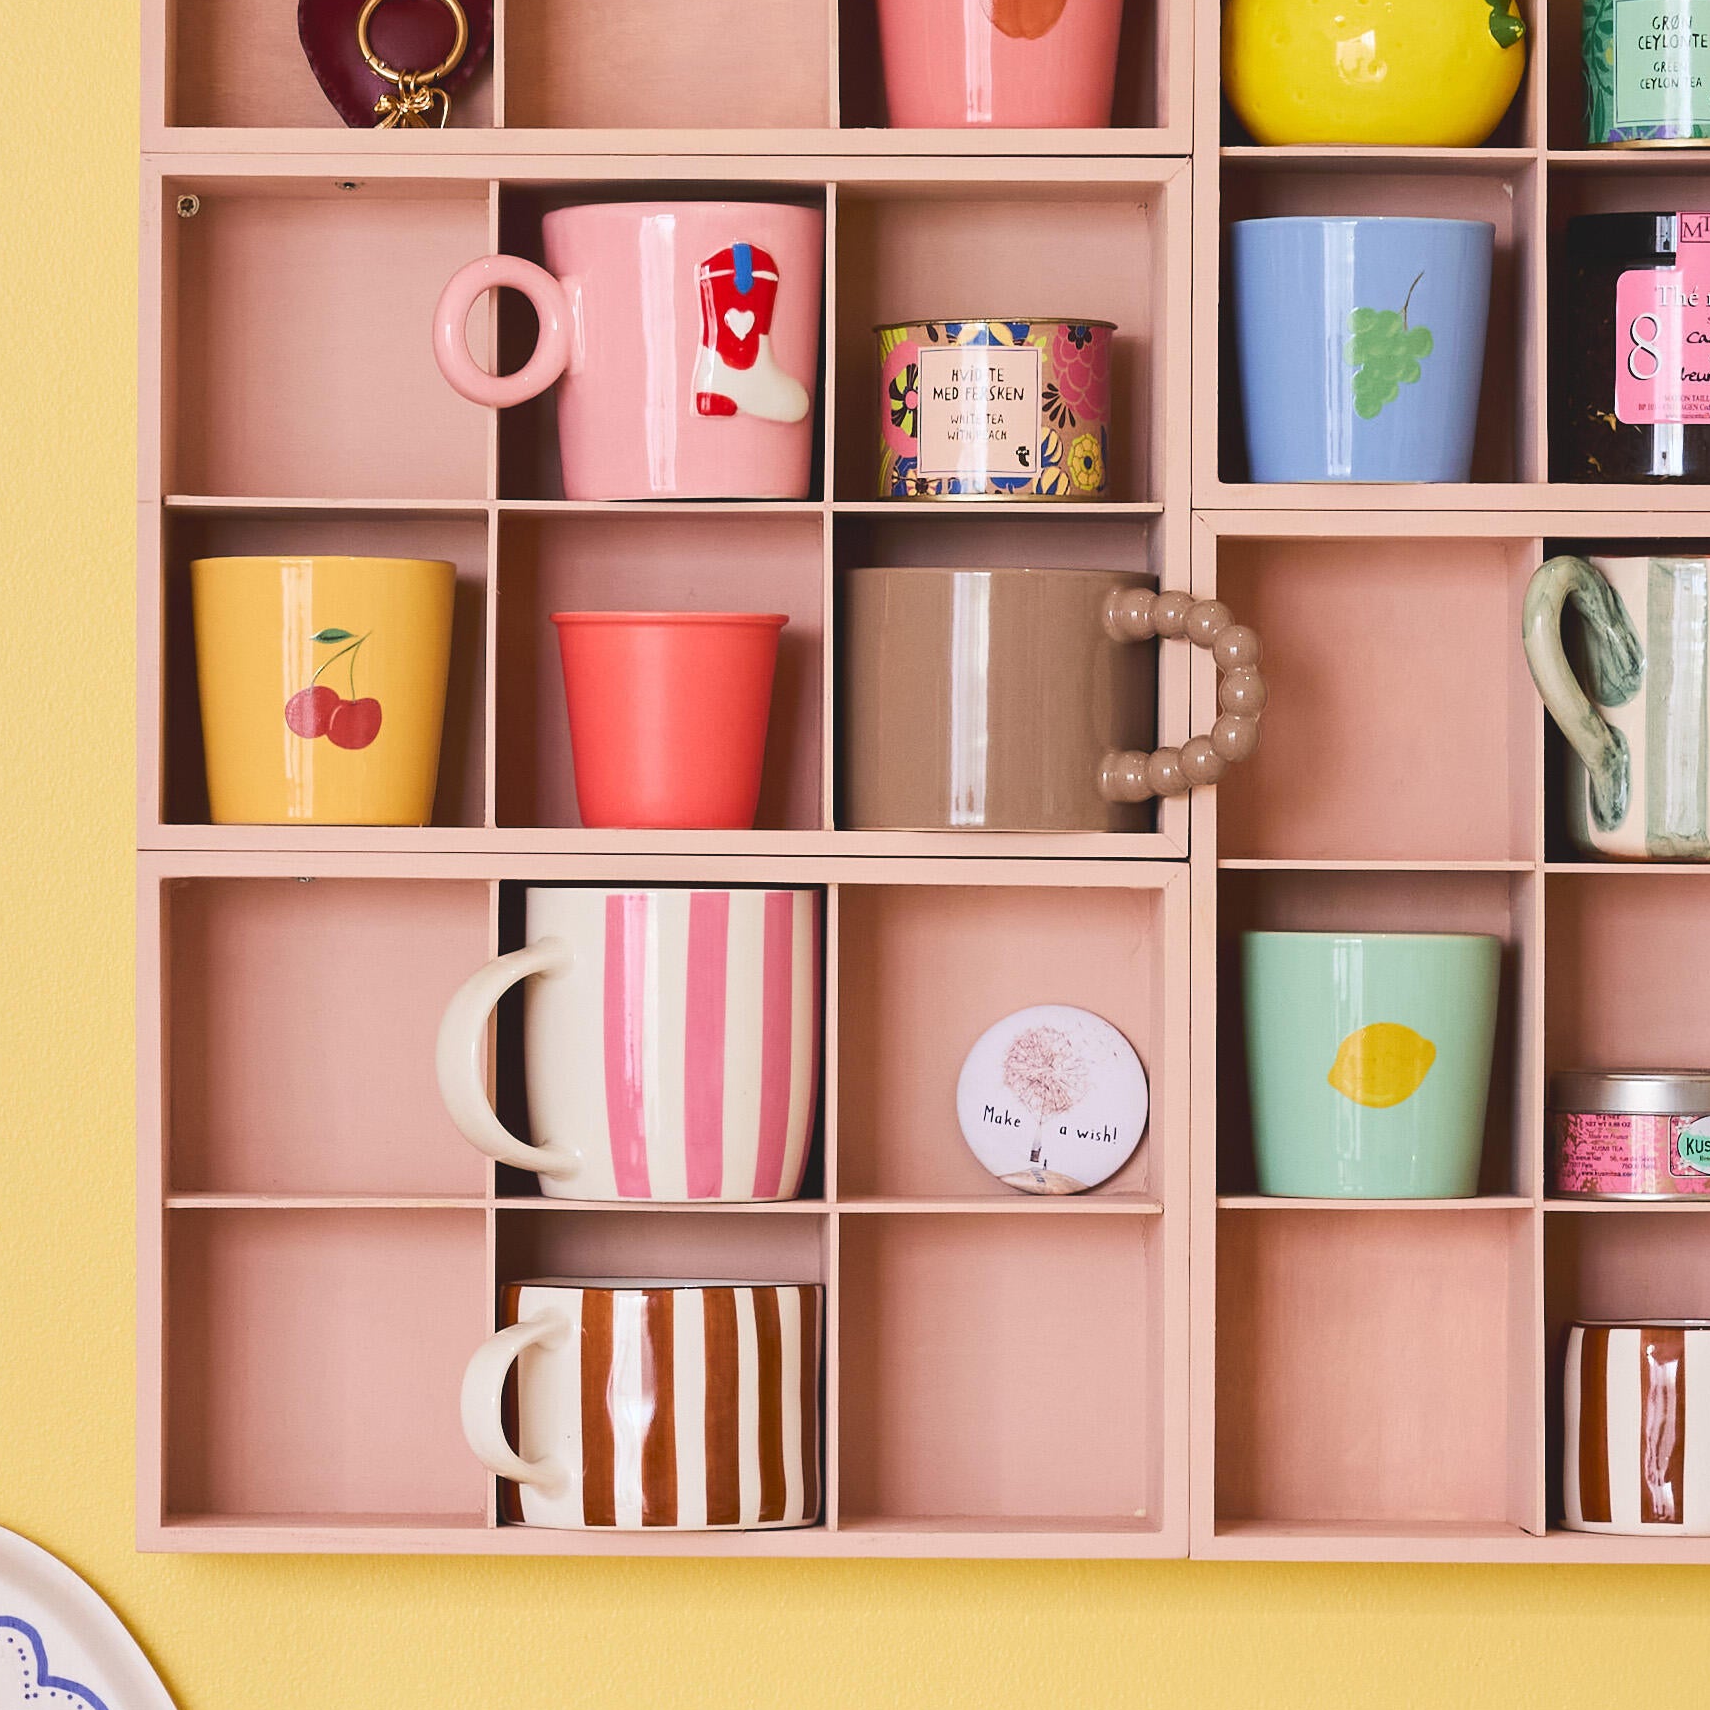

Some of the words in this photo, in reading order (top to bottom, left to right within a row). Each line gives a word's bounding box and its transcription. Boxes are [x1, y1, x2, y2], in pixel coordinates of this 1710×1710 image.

[1653, 61, 1689, 73] GREE
[1640, 77, 1679, 91] CEYLON
[1655, 285, 1700, 308] Thé
[1627, 312, 1663, 381] 8
[988, 367, 1005, 383] TE
[932, 386, 959, 402] MED
[986, 413, 1004, 425] TEA
[976, 430, 1007, 442] ACH
[983, 1104, 1021, 1128] Make
[1059, 1125, 1067, 1136] a
[1076, 1124, 1118, 1145] wish!
